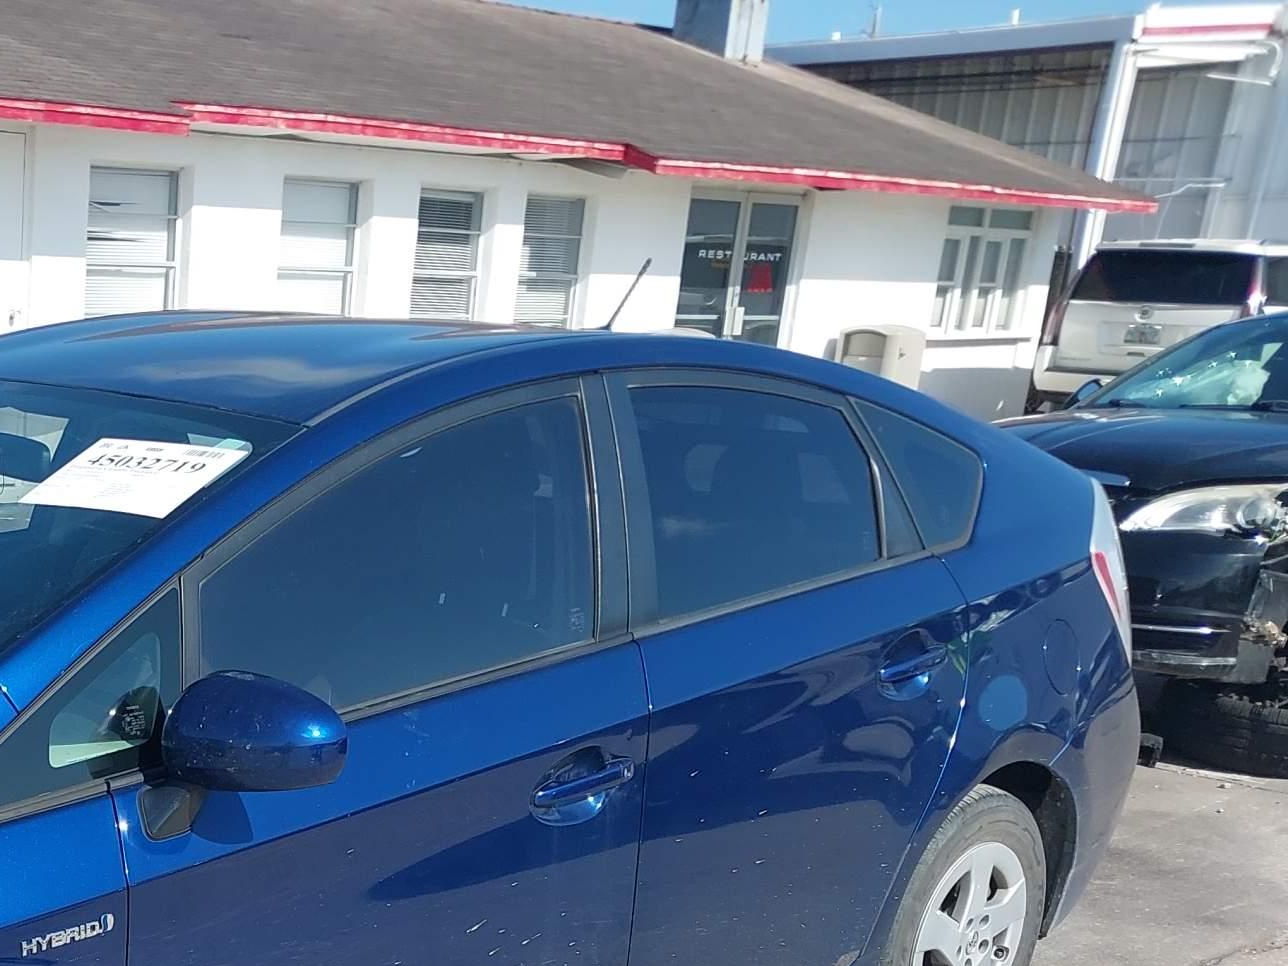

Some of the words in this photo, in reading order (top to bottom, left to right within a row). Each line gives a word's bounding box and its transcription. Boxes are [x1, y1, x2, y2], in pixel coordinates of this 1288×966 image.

[697, 249, 782, 262] RESTURANT
[88, 453, 207, 474] 45032719
[21, 920, 103, 957] HYBRID
